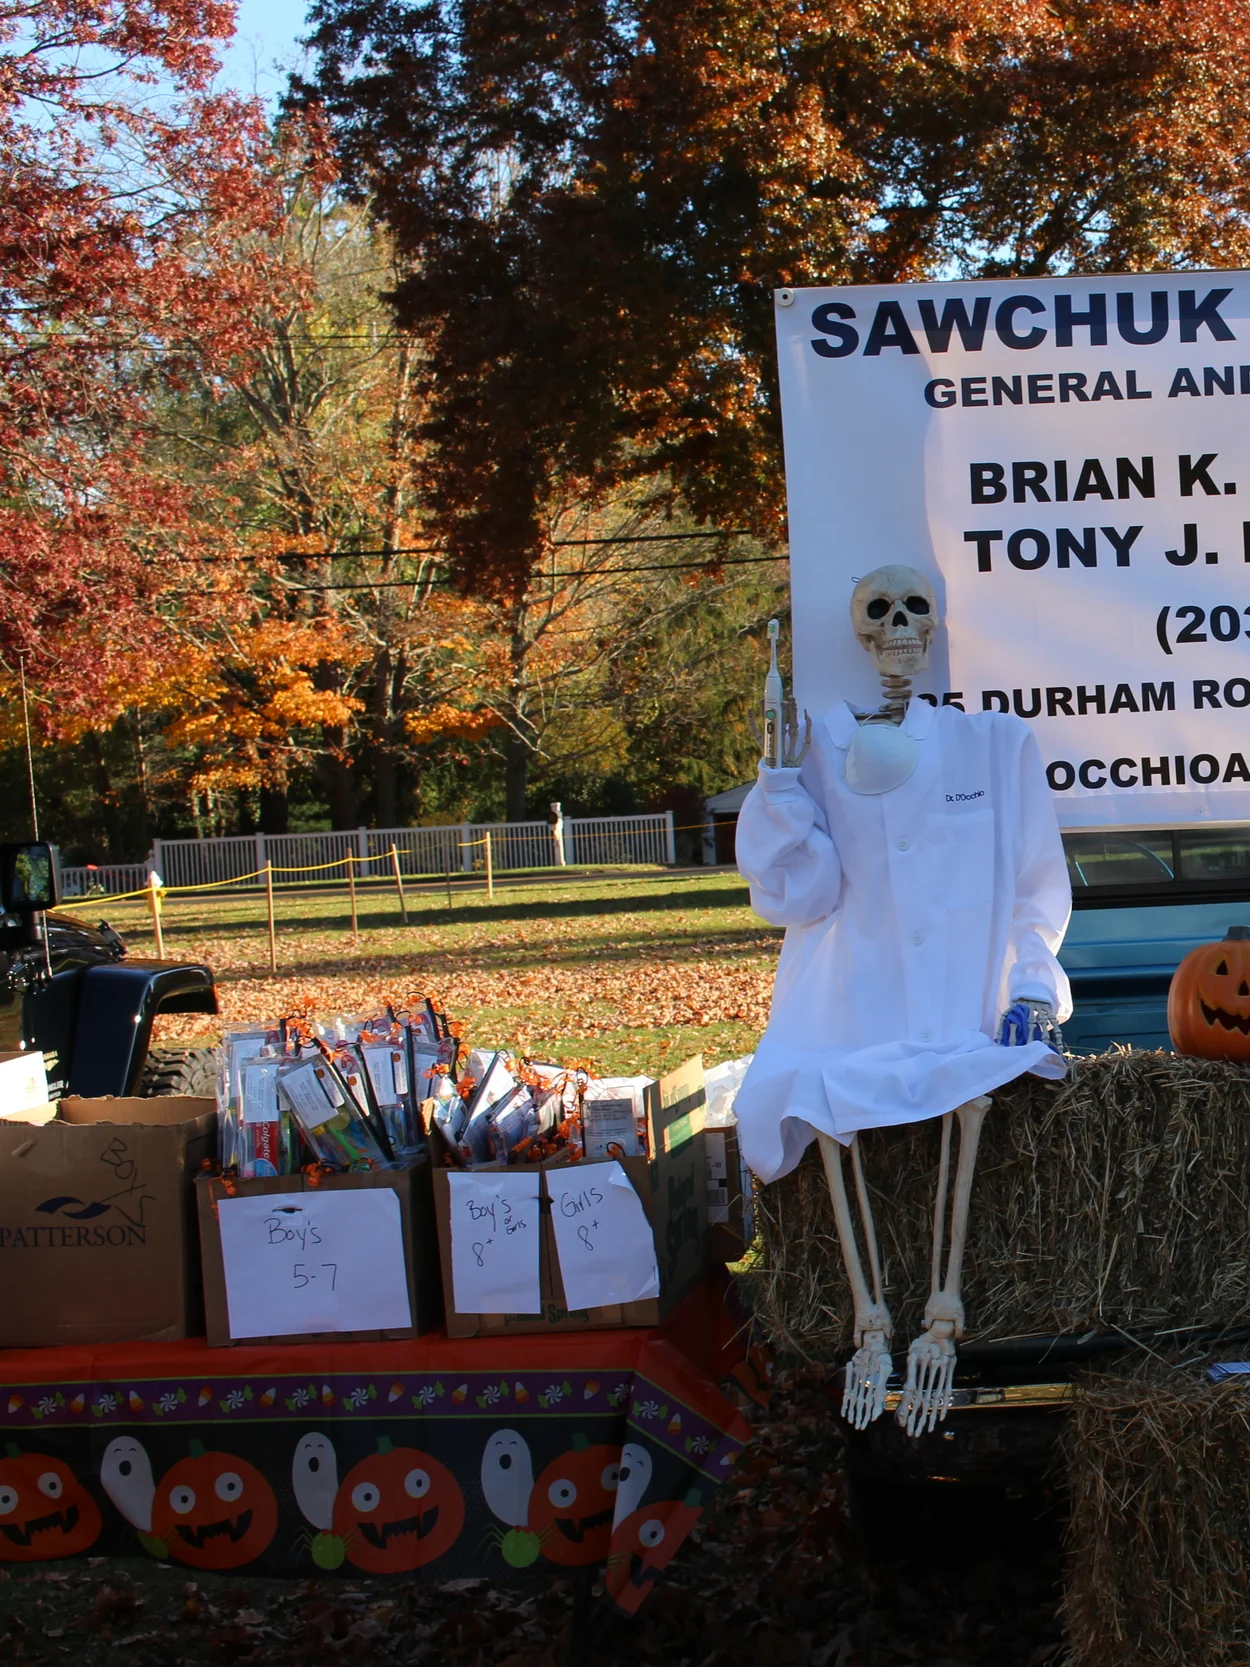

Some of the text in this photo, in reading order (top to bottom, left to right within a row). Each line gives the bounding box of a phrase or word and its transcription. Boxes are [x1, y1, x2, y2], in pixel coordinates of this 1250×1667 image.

[810, 288, 1237, 358] SAWCHUK
[924, 369, 1152, 409] GENERAL
[969, 456, 1156, 505] BRIAN
[1178, 453, 1237, 497] K.
[963, 525, 1144, 573] TONY
[1164, 523, 1219, 566] J.
[981, 681, 1176, 719] DURHAM
[0, 1223, 148, 1248] PATTERSON
[293, 1263, 339, 1292] 5-7
